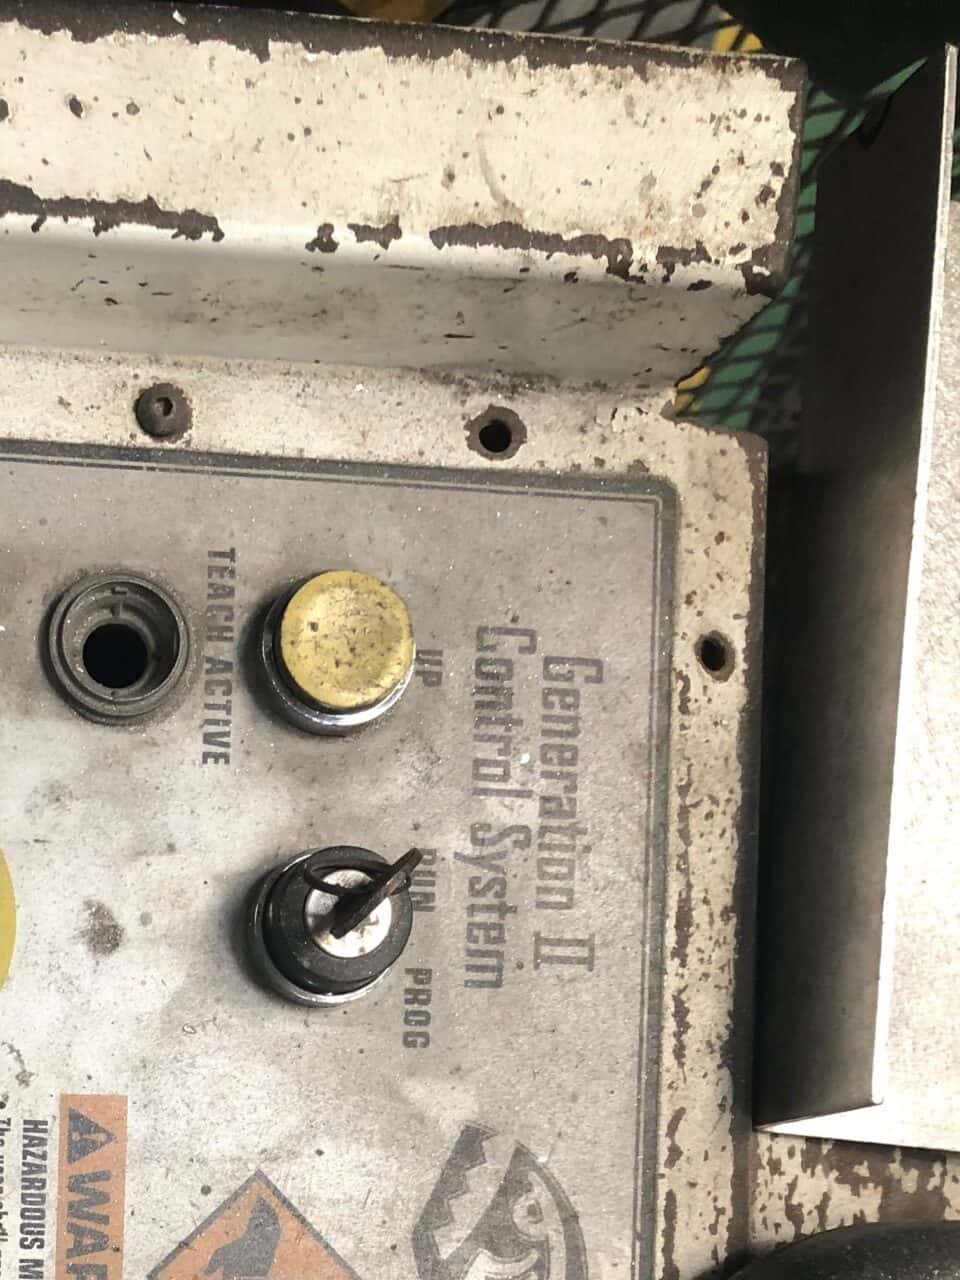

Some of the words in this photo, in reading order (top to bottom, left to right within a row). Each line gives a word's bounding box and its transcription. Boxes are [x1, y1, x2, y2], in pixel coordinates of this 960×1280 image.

[206, 548, 236, 643] TEACH
[201, 656, 233, 765] ACTIVE
[415, 649, 443, 688] UP
[472, 625, 537, 800] Control
[535, 655, 604, 911] Generation
[454, 823, 532, 989] System
[403, 968, 433, 1049] PROG
[19, 1119, 49, 1250] HAZARDOUS
